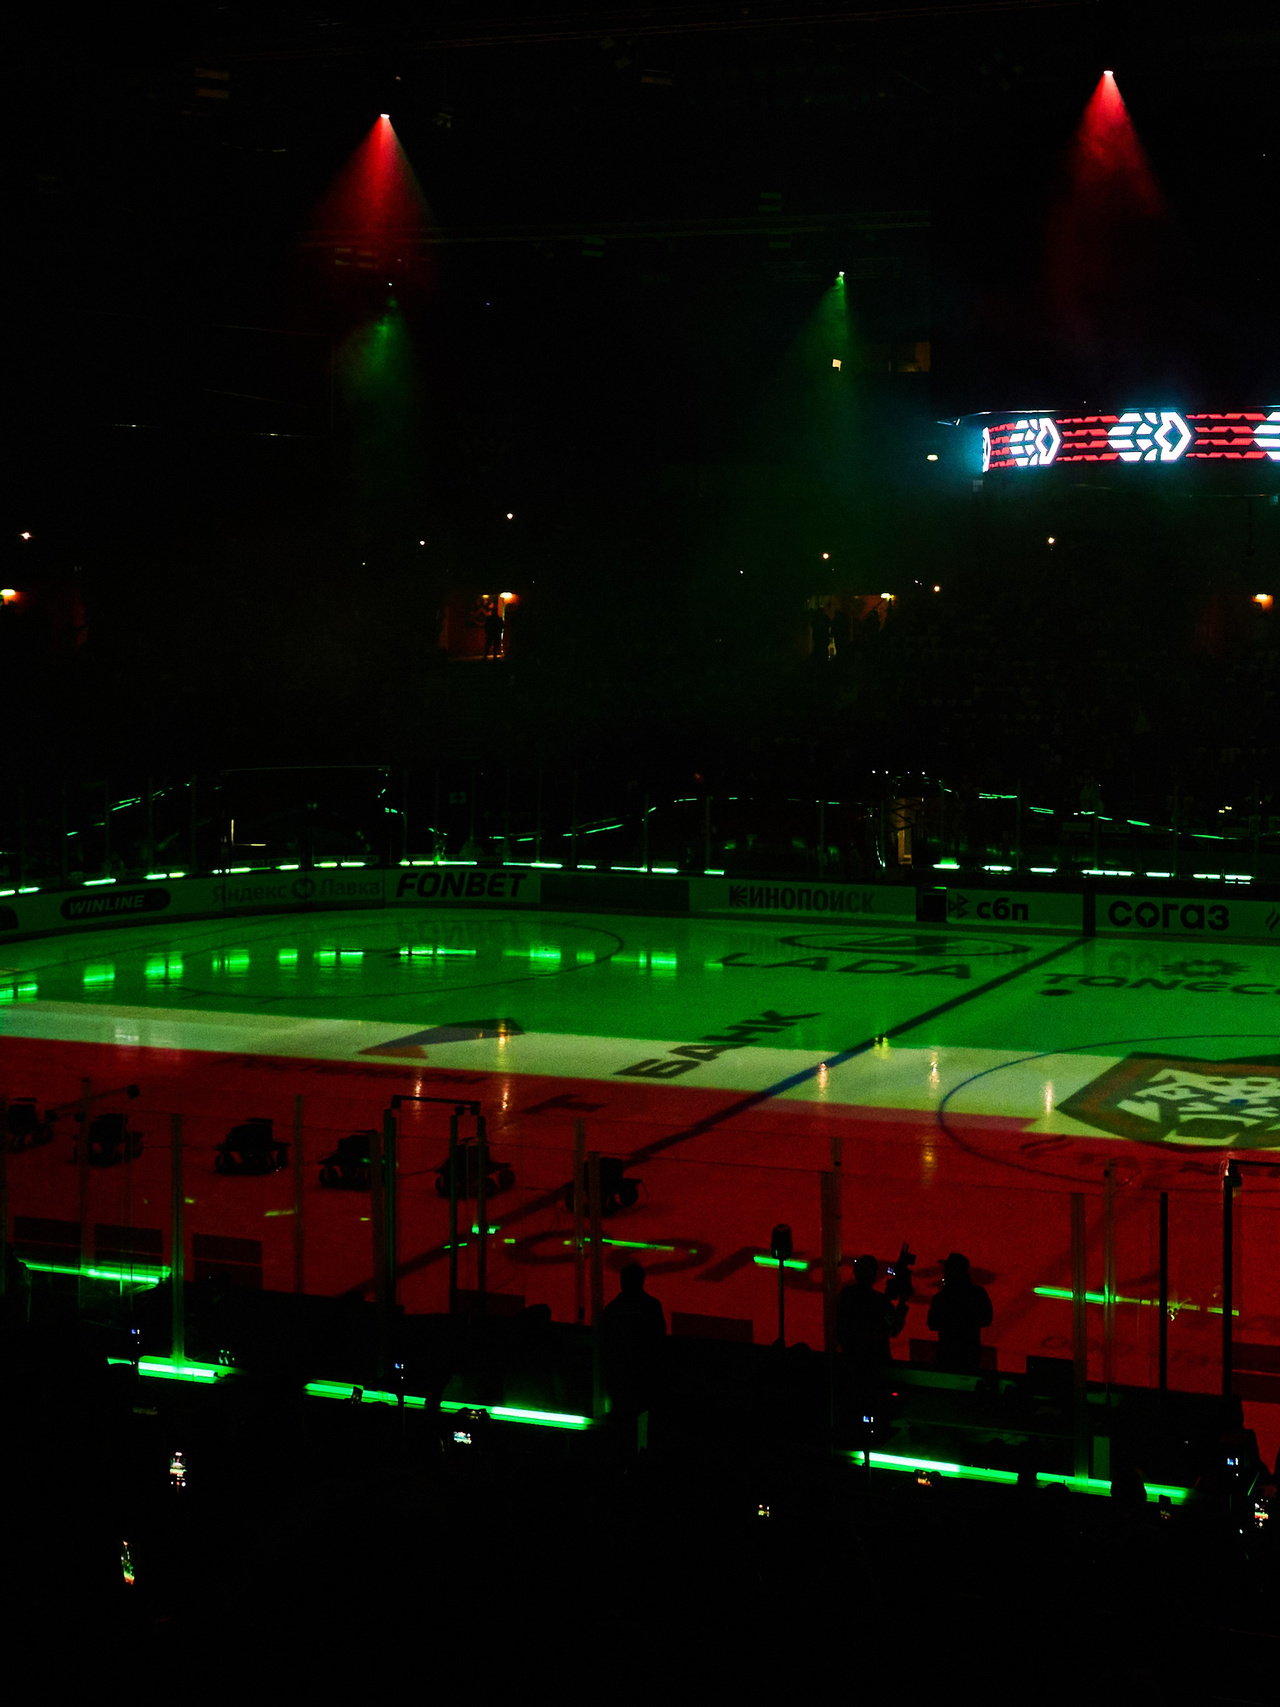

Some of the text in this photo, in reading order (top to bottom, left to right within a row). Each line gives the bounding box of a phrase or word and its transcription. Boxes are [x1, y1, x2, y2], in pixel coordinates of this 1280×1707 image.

[396, 871, 527, 899] FONBET
[67, 893, 145, 916] WINLINE
[975, 896, 1029, 921] сбп
[1108, 900, 1230, 930] согаз
[719, 950, 972, 980] LADA
[616, 1008, 818, 1079] БАНК
